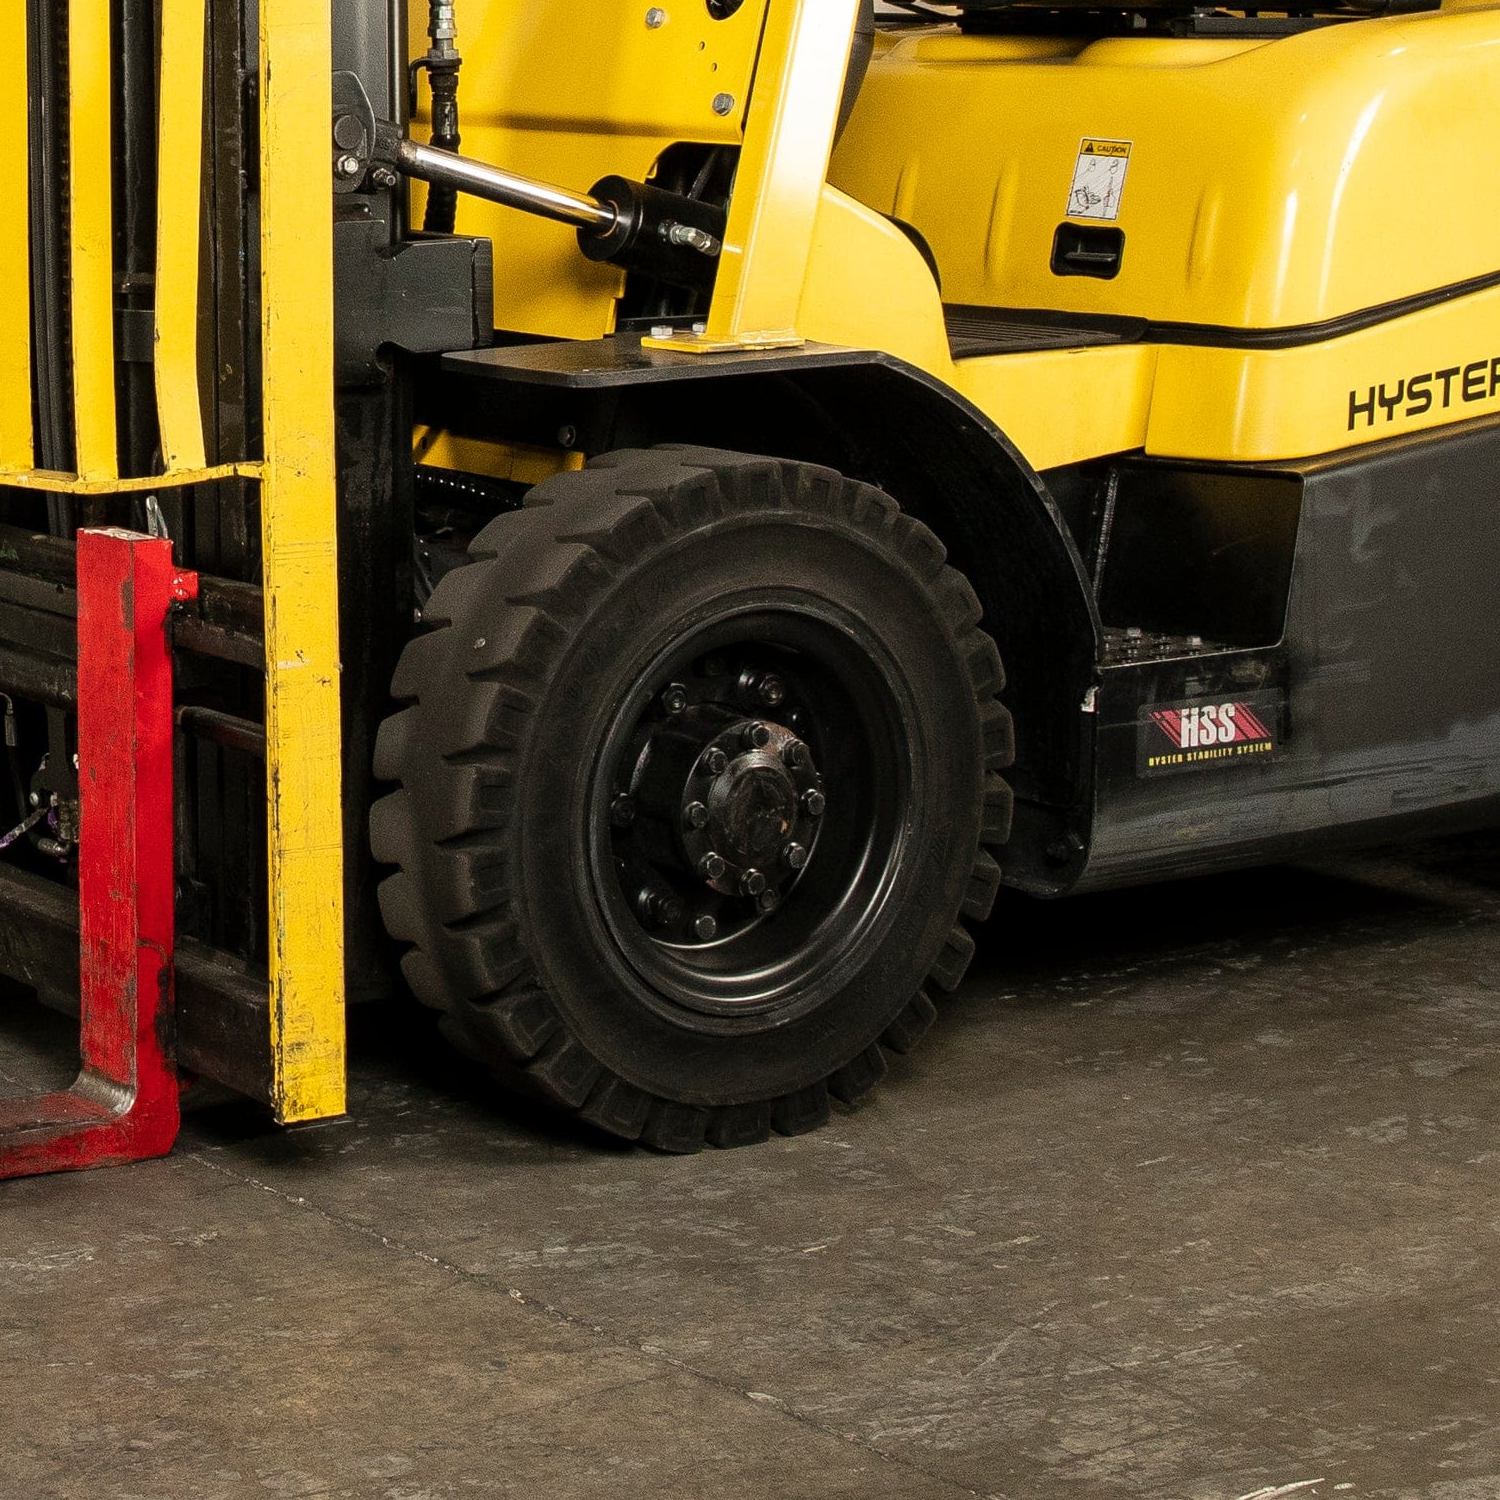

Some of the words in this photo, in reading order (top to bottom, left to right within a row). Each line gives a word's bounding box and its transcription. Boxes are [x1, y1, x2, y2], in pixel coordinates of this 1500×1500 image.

[1098, 145, 1127, 153] CAUTION
[1180, 703, 1236, 748] HSS
[1187, 748, 1233, 761] STABILITY
[1237, 742, 1272, 755] SYSTEM
